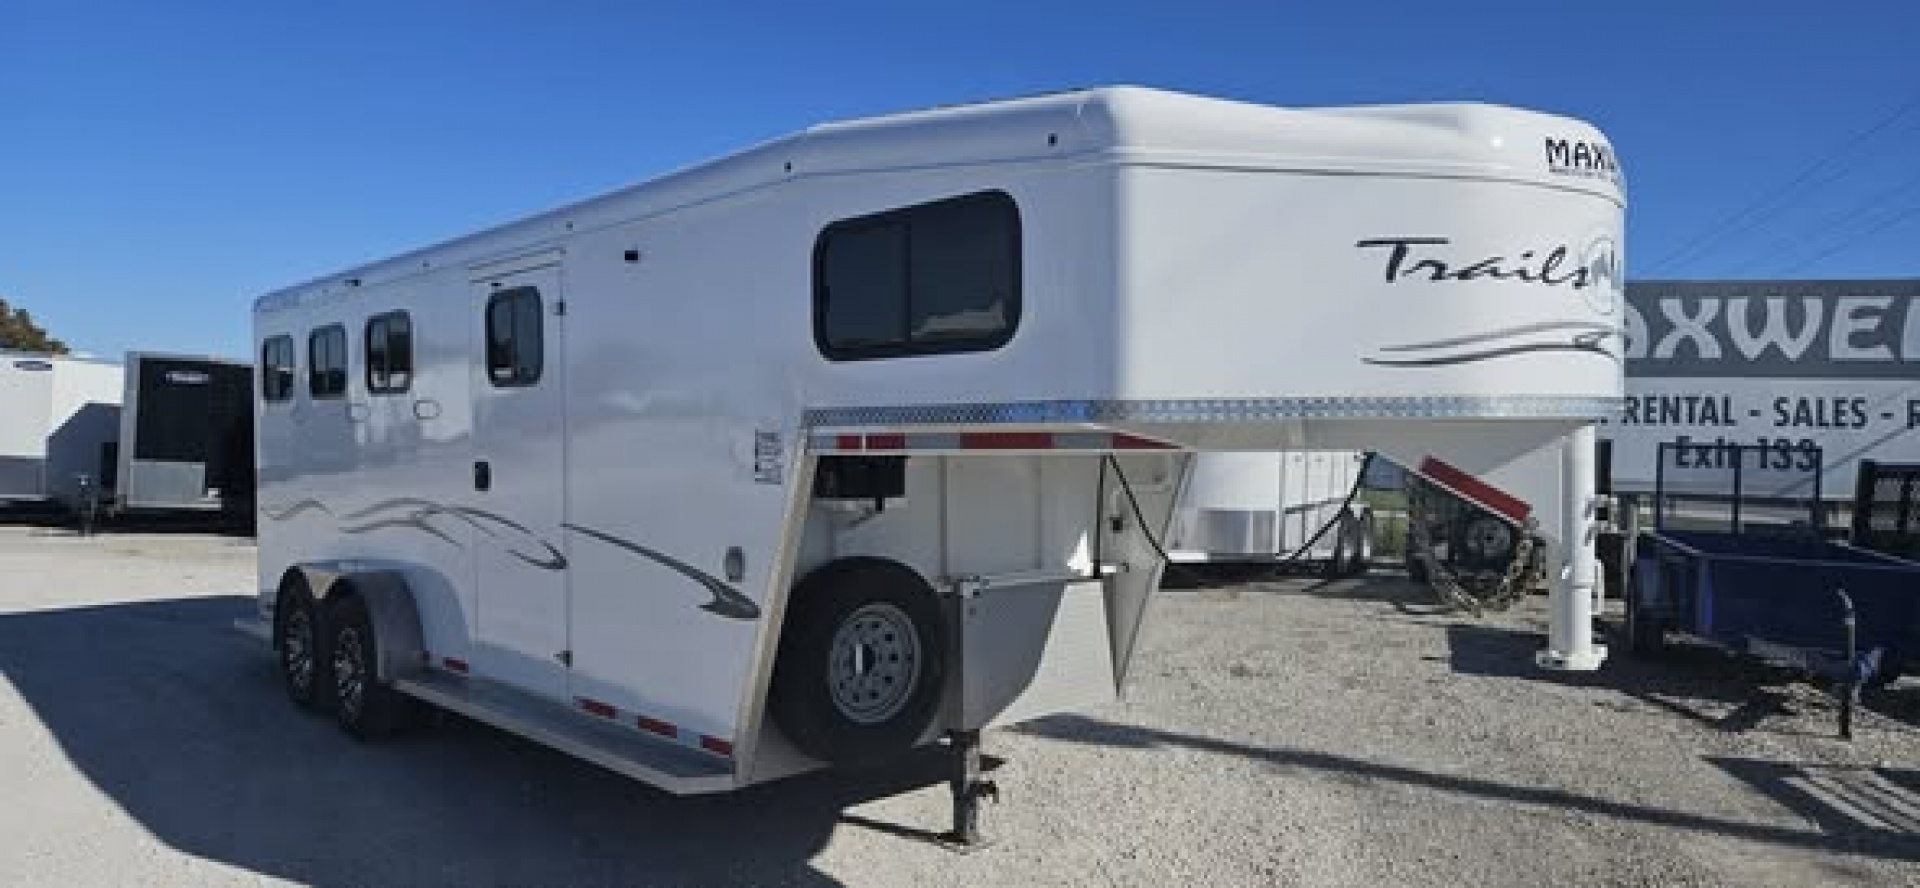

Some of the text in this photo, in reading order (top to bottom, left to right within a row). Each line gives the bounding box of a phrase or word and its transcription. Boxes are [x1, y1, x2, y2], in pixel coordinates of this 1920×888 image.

[1355, 236, 1587, 289] Trails
[1621, 396, 1737, 424] RENTAL
[1773, 397, 1868, 428] SALES
